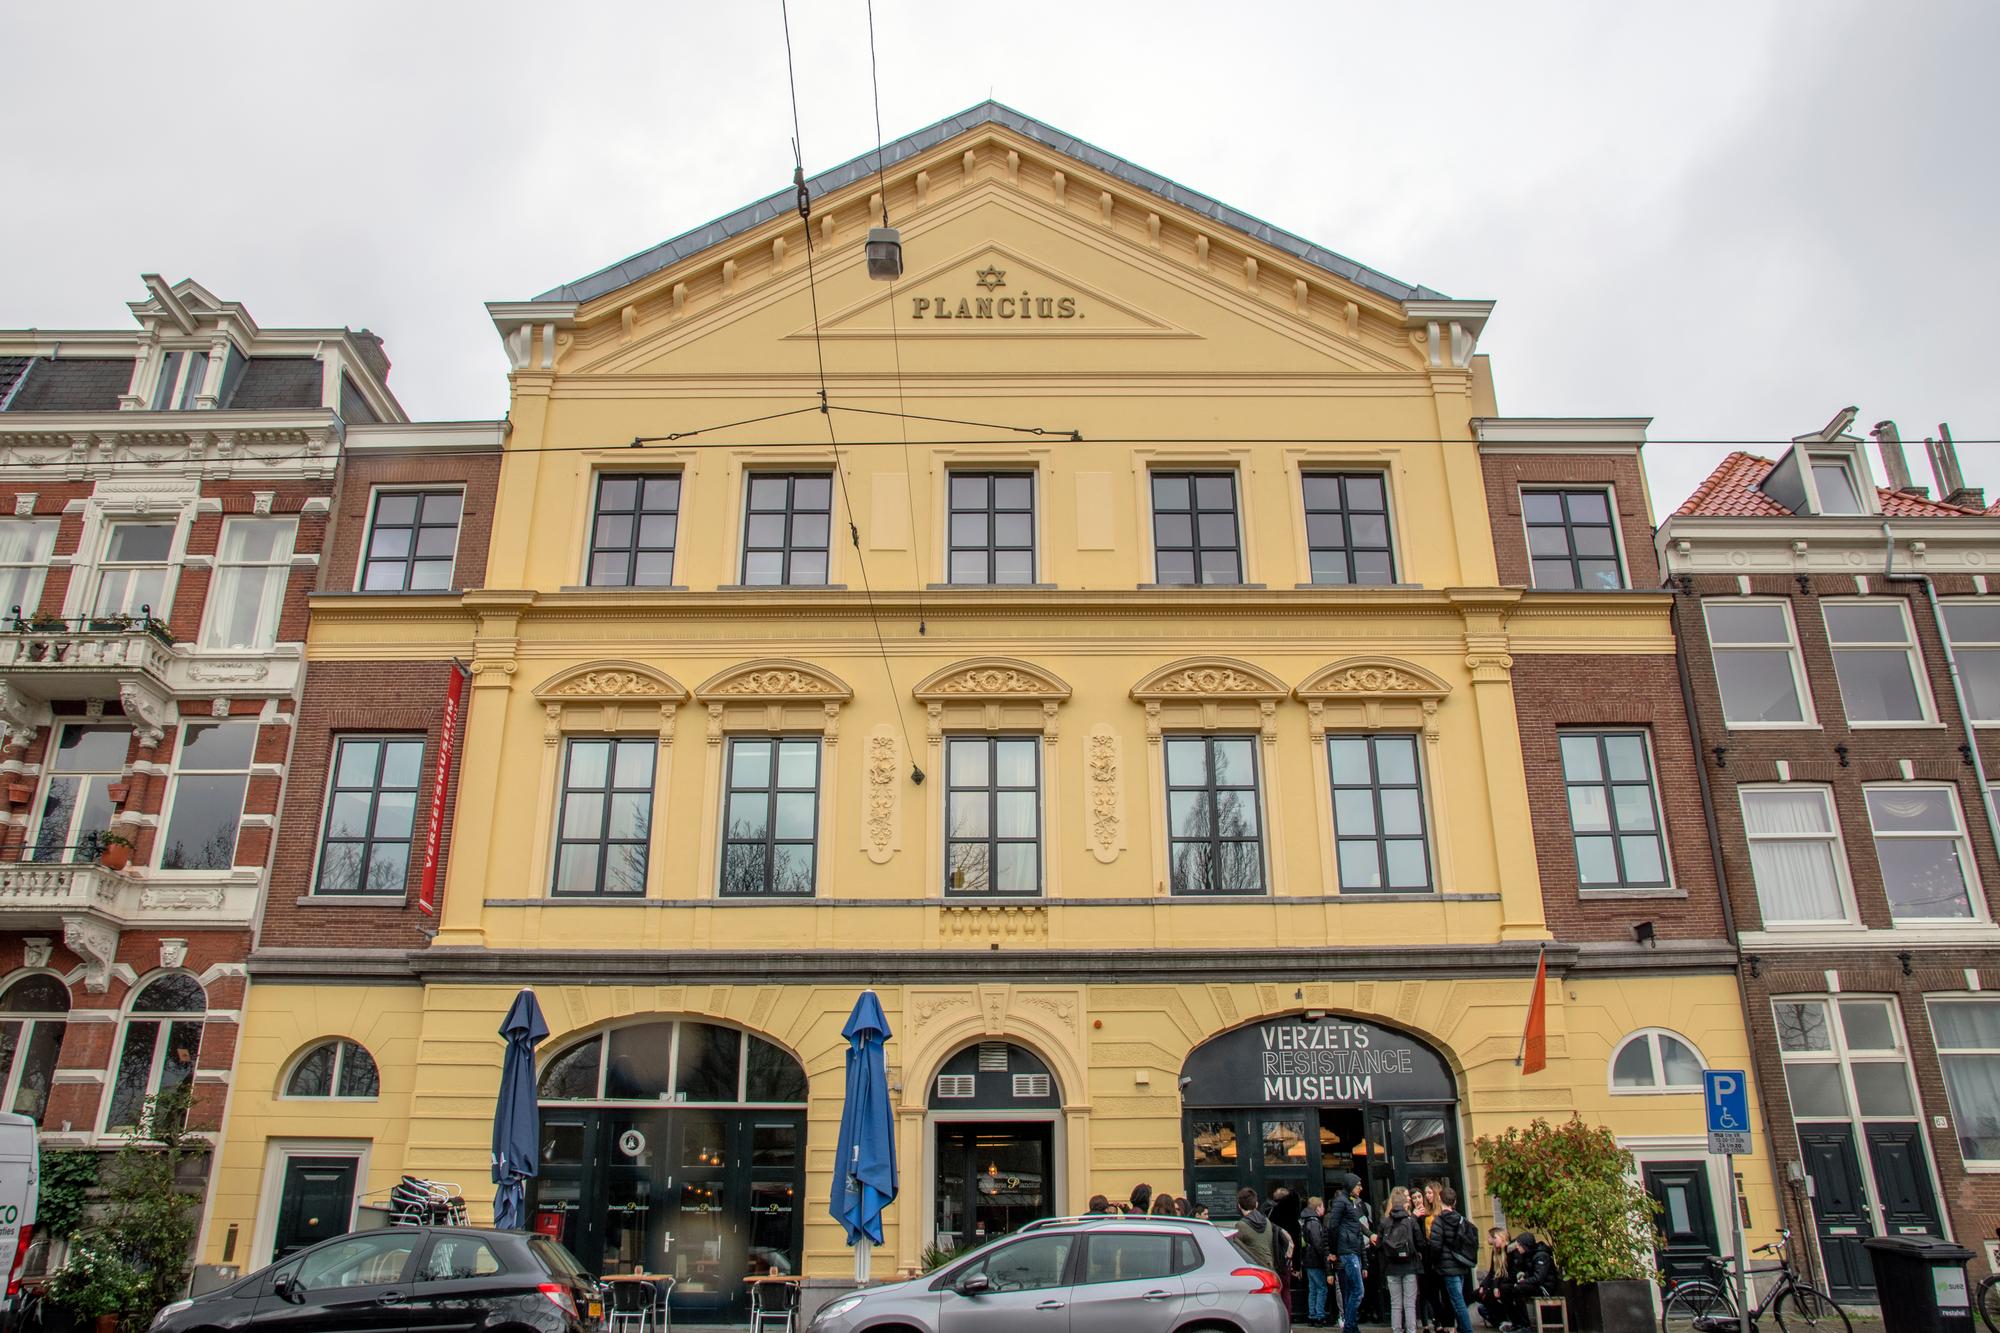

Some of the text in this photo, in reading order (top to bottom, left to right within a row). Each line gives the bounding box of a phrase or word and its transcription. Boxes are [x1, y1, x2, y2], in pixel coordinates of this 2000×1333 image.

[426, 697, 454, 868] VERZETSMUSEUM
[1261, 1025, 1369, 1050] VERZETS
[1262, 1049, 1413, 1075] RESISTANCE
[1264, 1076, 1373, 1101] MUSEUM
[1714, 1075, 1737, 1105] P
